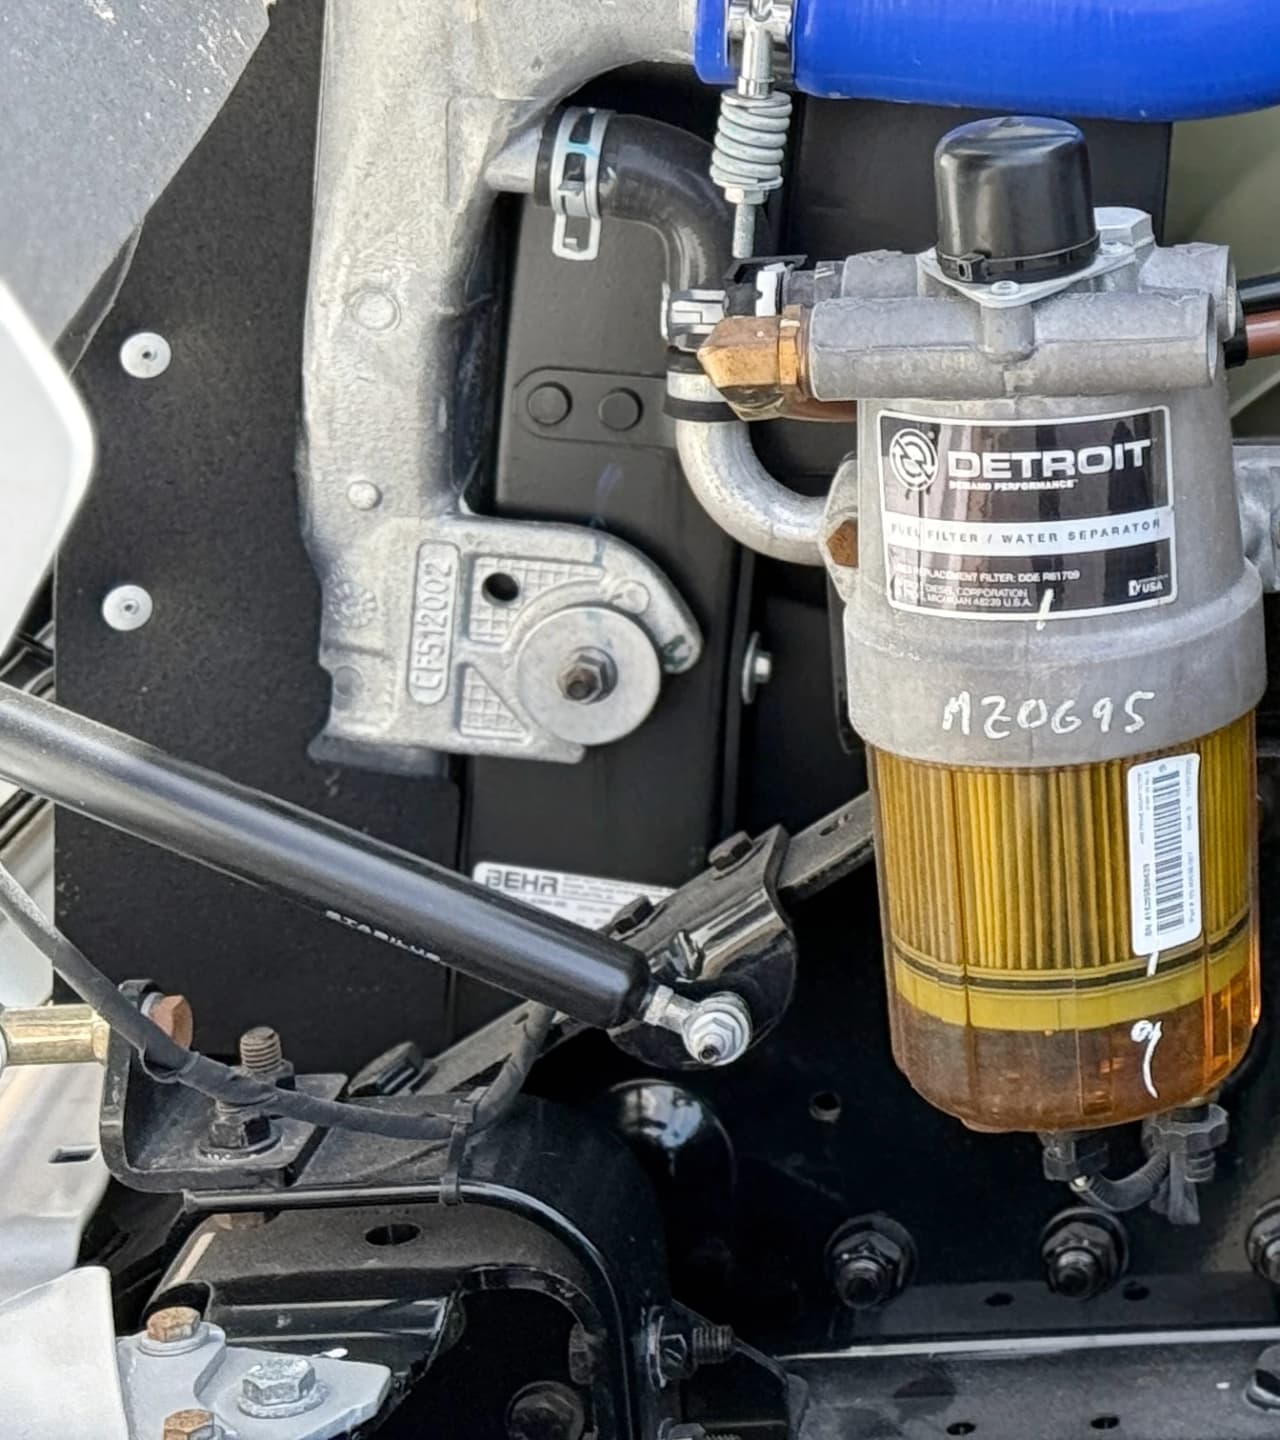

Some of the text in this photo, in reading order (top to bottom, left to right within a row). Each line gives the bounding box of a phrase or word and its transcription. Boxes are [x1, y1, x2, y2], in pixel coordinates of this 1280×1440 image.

[946, 438, 1152, 480] DETROIT
[890, 522, 921, 540] FUEL
[926, 528, 979, 545] FILTER
[1001, 532, 1060, 545] WATER
[1067, 519, 1161, 542] SEPARATOR
[1142, 579, 1164, 594] USA
[485, 867, 560, 895] BEHR
